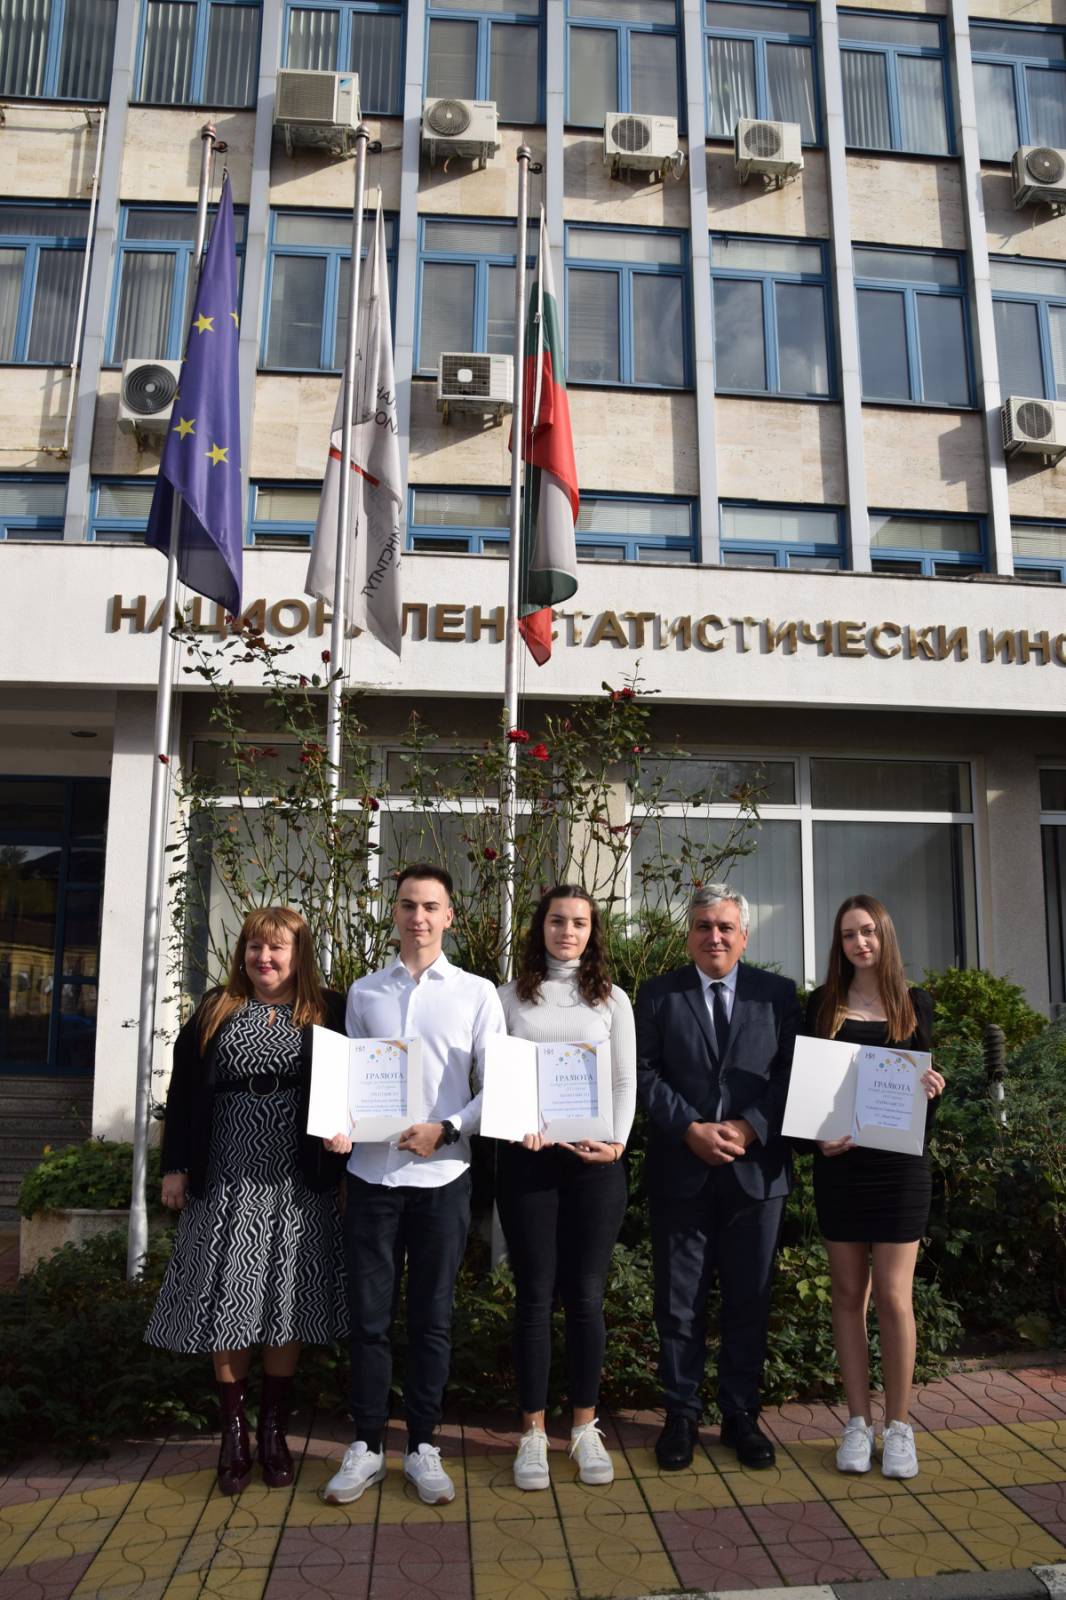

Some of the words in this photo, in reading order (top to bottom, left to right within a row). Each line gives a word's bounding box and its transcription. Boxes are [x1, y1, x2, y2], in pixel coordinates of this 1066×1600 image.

[111, 593, 505, 642] НАЦИОНЛЕН
[551, 607, 968, 660] ТАТИСТИЧЕСКИ
[365, 1072, 405, 1080] ГРАМОТА
[555, 1073, 593, 1082] ГРАМОТА
[873, 1080, 911, 1092] ГРАМОТА
